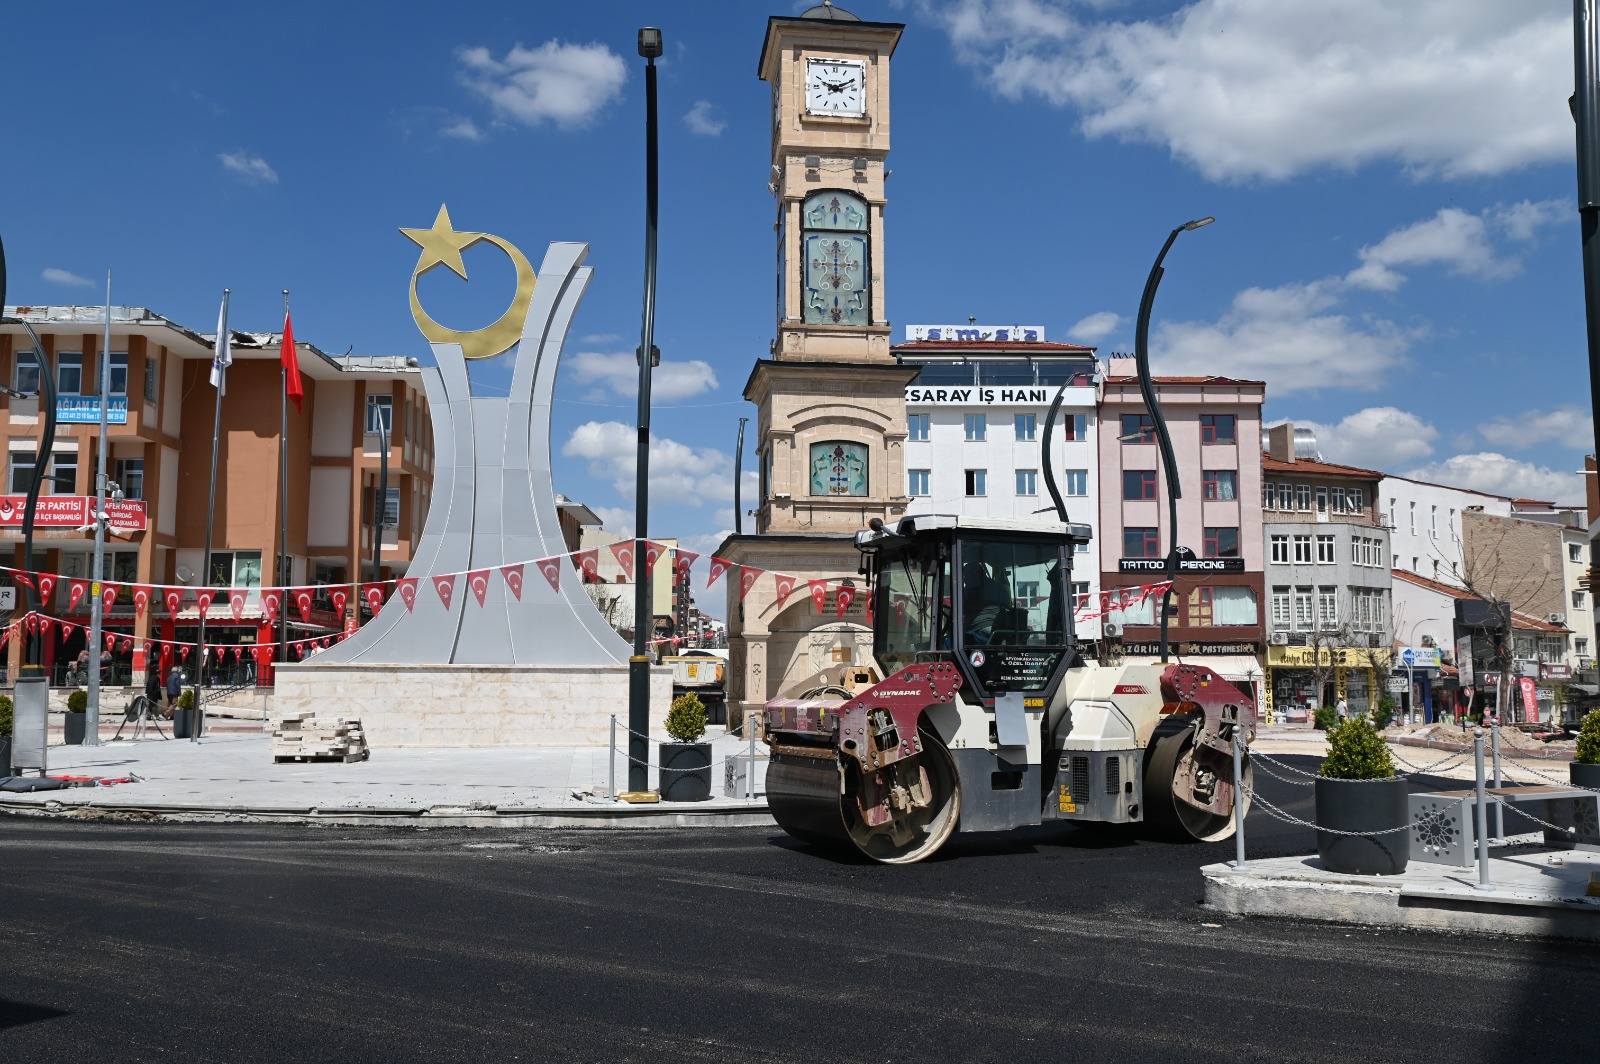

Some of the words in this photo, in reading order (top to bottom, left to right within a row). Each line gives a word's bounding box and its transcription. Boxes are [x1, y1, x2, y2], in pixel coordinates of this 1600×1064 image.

[979, 387, 995, 404] İŞ
[1001, 389, 1047, 402] HANI
[48, 500, 81, 510] PARTİSİ
[1122, 561, 1164, 569] TATTOO
[1180, 561, 1224, 569] PIERCING
